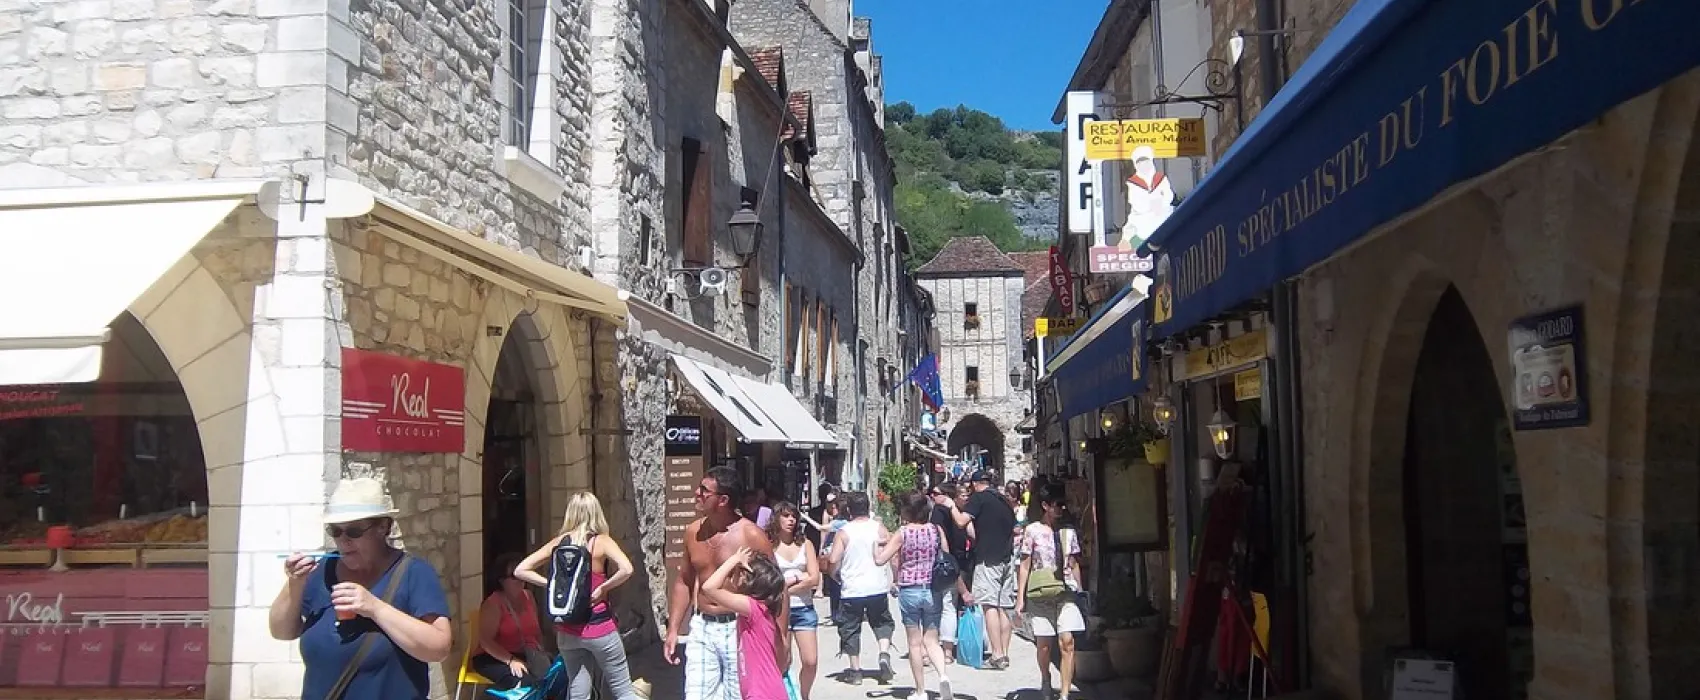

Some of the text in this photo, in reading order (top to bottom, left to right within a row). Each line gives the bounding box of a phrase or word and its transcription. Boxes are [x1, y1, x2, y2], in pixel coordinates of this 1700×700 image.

[1090, 122, 1197, 136] RESTAURANT
[1092, 133, 1198, 145] Chez Anne Marie
[1237, 131, 1370, 258] SPÉCIALISTE
[1377, 84, 1429, 170] DU
[1439, 0, 1559, 128] FOIE
[1099, 262, 1153, 271] REGIO
[1051, 253, 1072, 307] TABAC
[391, 372, 429, 418] Real
[376, 426, 440, 437] CHOCOLAT
[7, 592, 63, 625] Real
